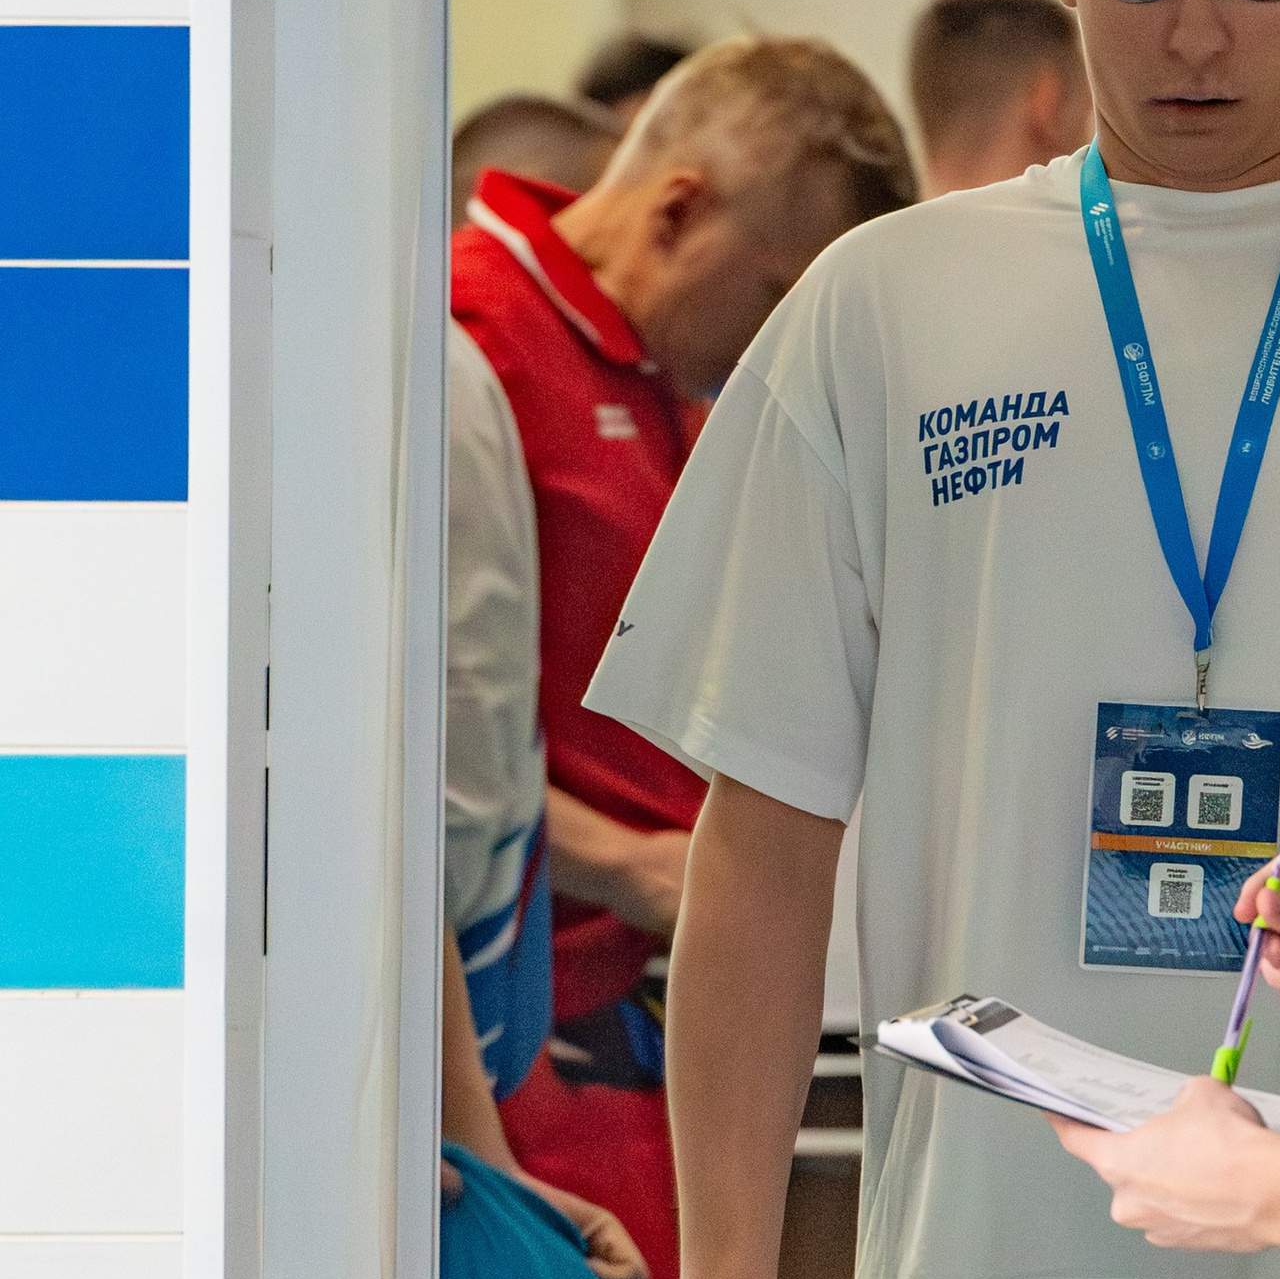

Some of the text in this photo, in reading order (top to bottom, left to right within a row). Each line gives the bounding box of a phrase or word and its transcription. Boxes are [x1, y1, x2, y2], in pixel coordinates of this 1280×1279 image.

[1135, 361, 1155, 406] ВФПМ
[919, 390, 1070, 442] КОМАНДА
[923, 421, 1060, 475] ГАЗПРОМ
[932, 456, 1025, 506] НЕФТИ
